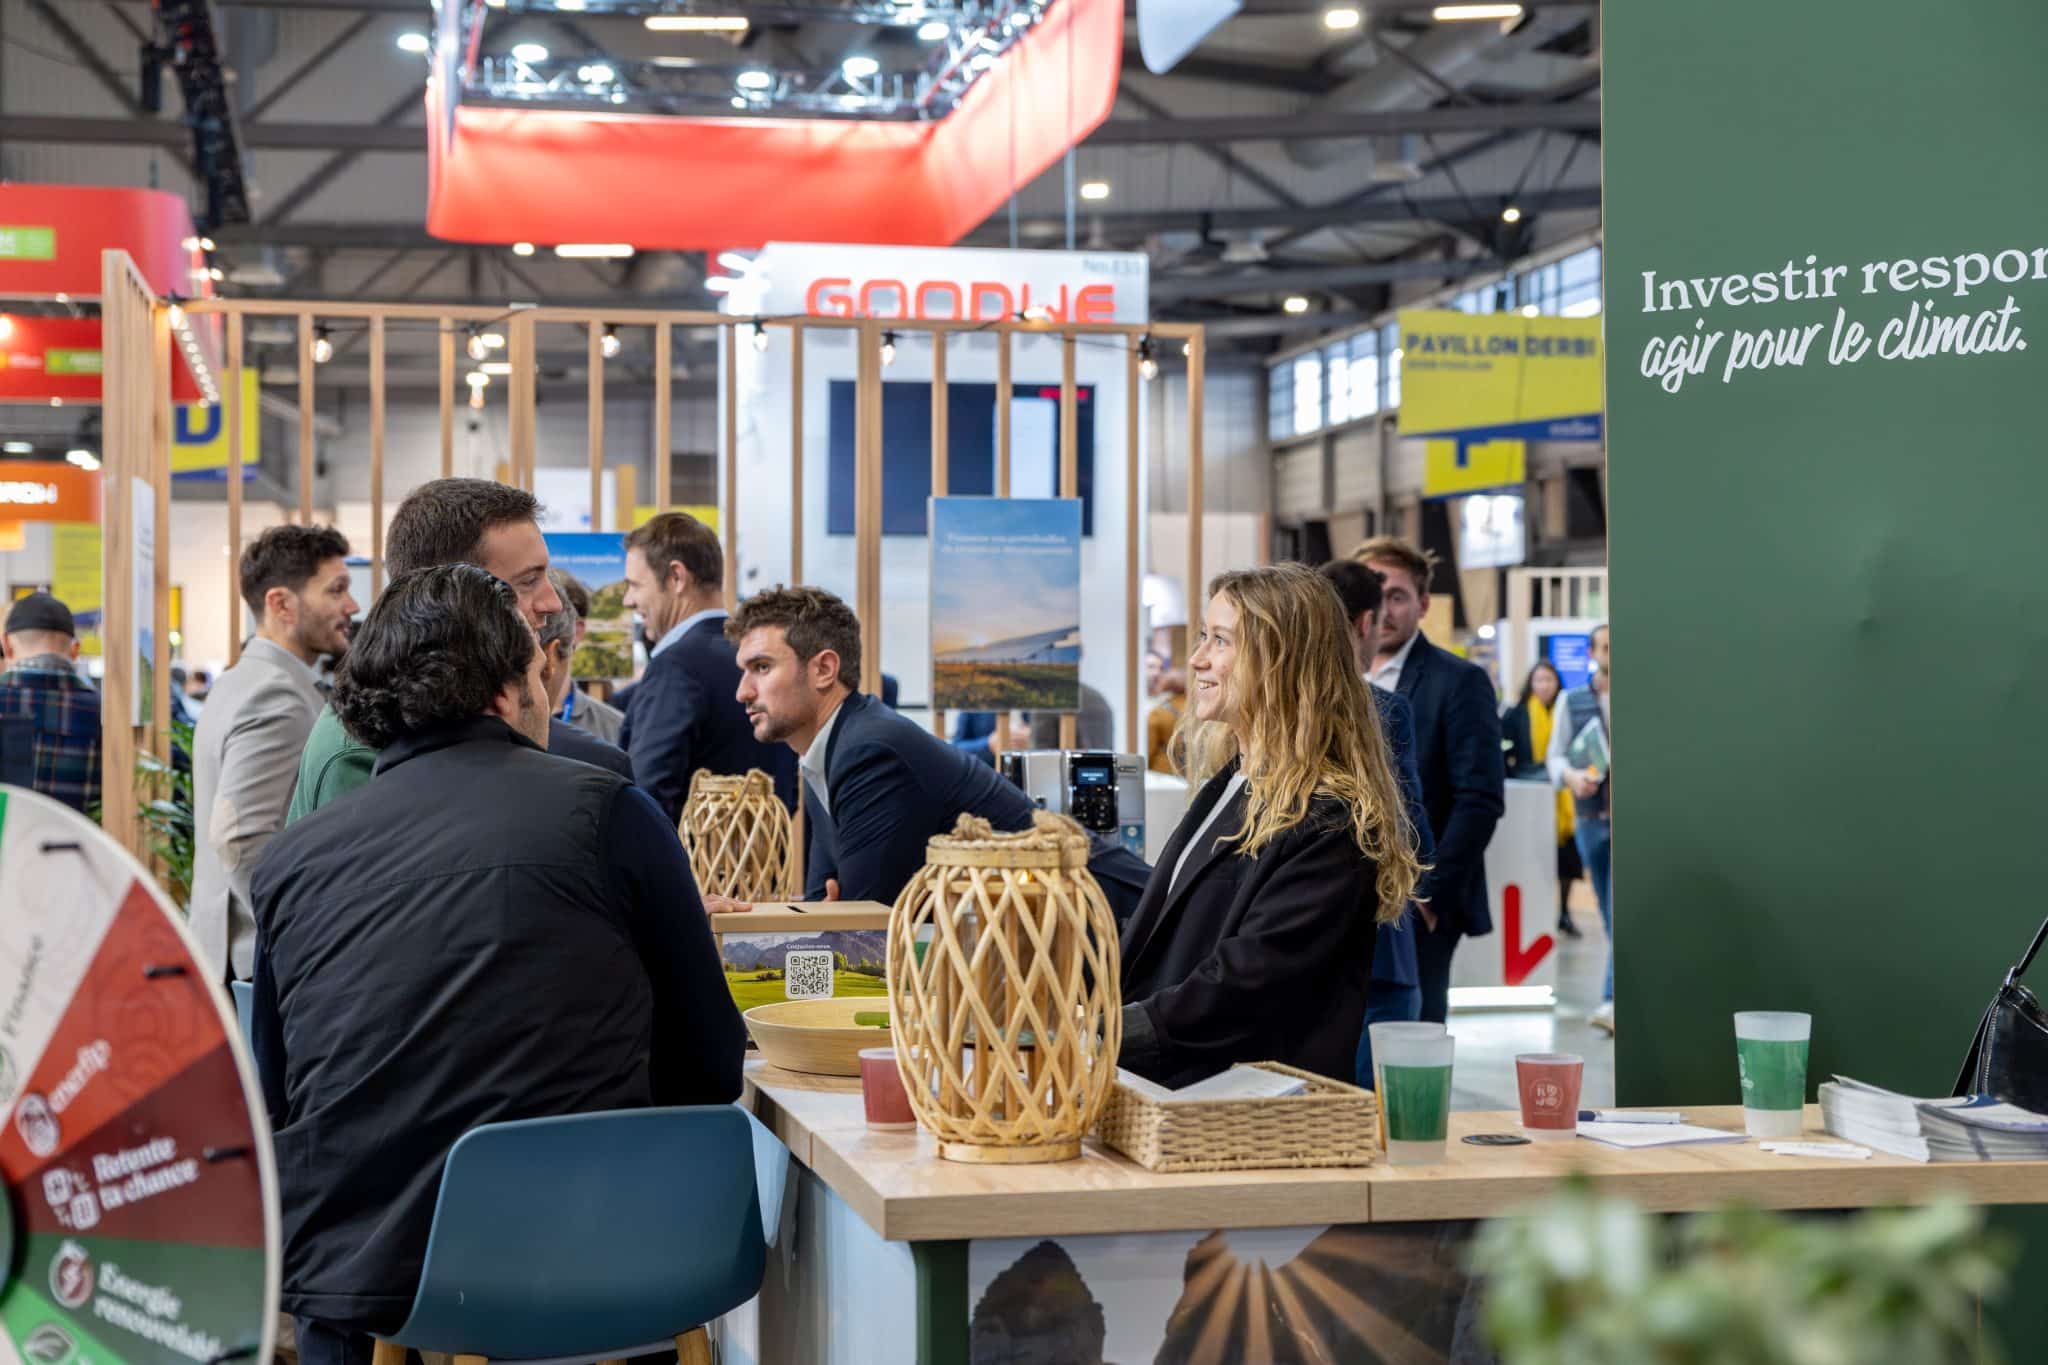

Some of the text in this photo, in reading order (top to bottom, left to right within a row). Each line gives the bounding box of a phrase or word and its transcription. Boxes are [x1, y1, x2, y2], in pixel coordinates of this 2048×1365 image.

[806, 277, 1117, 324] GOODWE
[1641, 254, 1848, 313] Investir
[1405, 333, 1597, 358] PAVILLON DERBI
[1640, 295, 2028, 394] agir pour le climat.
[92, 1136, 177, 1183] Retente
[98, 1158, 199, 1211] ta chance
